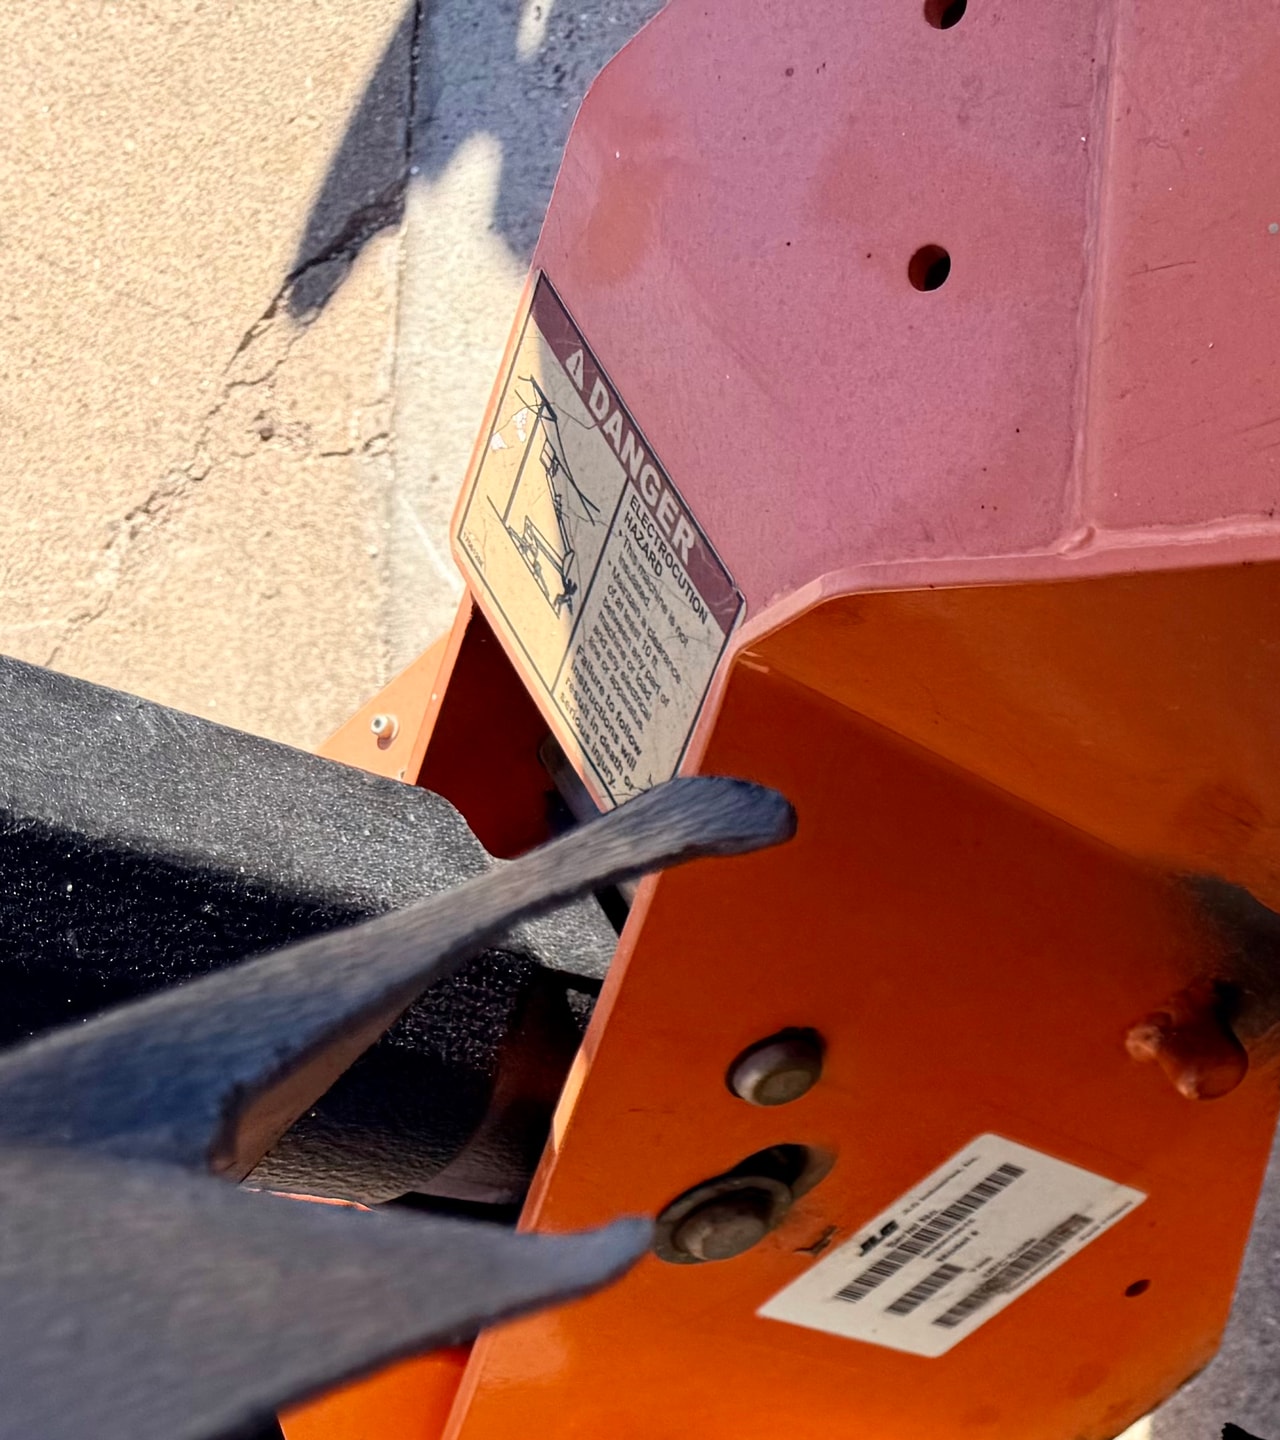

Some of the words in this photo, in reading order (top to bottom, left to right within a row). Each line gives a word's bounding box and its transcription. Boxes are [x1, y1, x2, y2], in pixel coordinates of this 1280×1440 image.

[587, 375, 695, 567] DANGER
[622, 534, 638, 566] This
[637, 559, 669, 616] machine
[667, 608, 676, 628] is
[623, 509, 663, 580] HAZARD
[629, 493, 707, 626] ELECTROCUTION
[592, 623, 607, 650] and
[605, 645, 620, 674] any
[619, 667, 652, 724] electrical
[597, 609, 627, 661] machine
[626, 657, 635, 675] or
[602, 595, 632, 649] between
[631, 644, 645, 673] any
[644, 665, 661, 697] part
[611, 564, 641, 619] Maintain
[646, 622, 682, 686] clearance
[622, 606, 641, 642] least
[641, 637, 652, 660] 10
[559, 689, 591, 746] serious
[565, 674, 590, 720] result
[590, 714, 599, 735] in
[599, 730, 624, 776] death
[623, 772, 634, 794] or
[570, 659, 620, 746] instructions
[620, 740, 636, 773] will
[575, 643, 605, 698] Failure
[605, 693, 615, 714] to
[615, 708, 643, 759] follow
[859, 1219, 900, 1256] JLG
